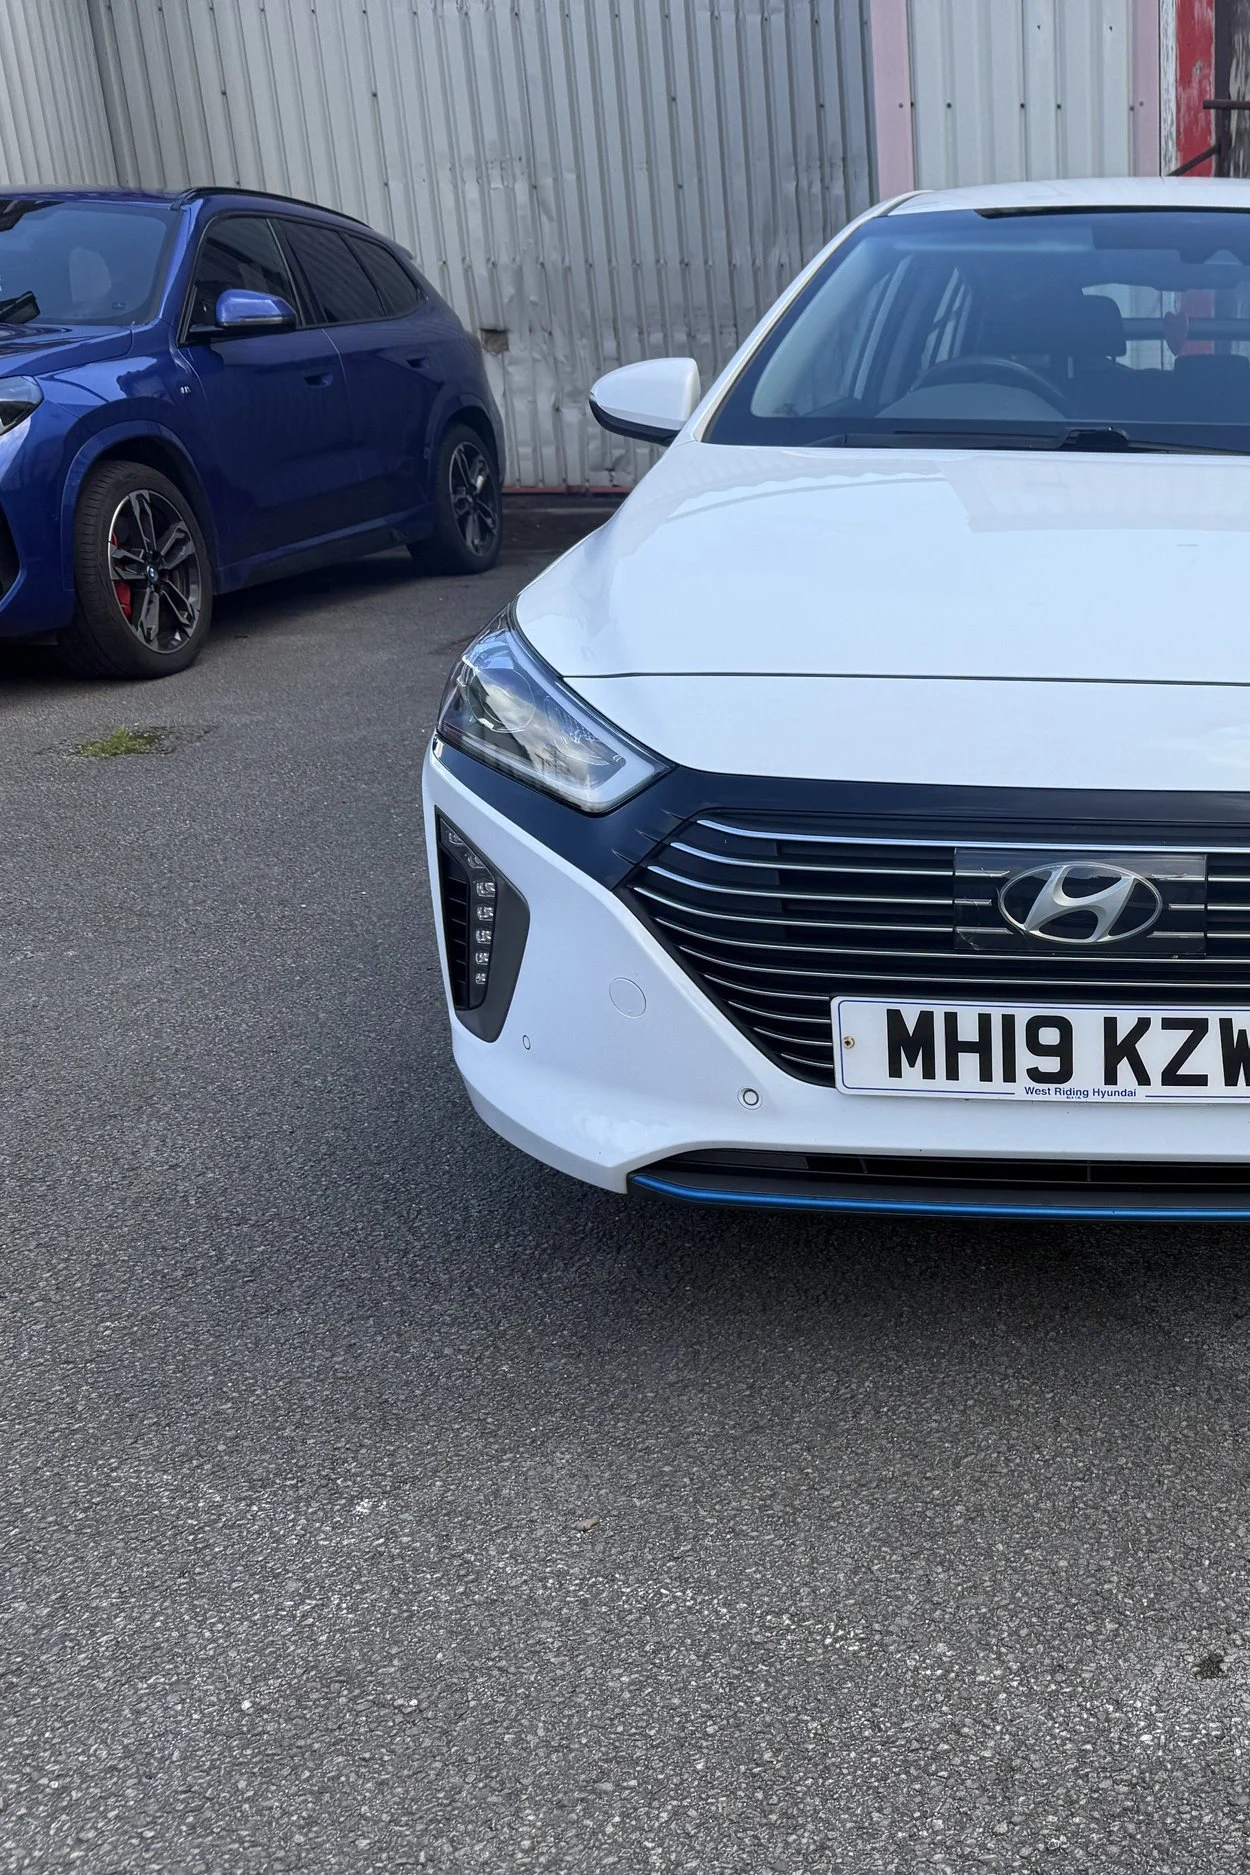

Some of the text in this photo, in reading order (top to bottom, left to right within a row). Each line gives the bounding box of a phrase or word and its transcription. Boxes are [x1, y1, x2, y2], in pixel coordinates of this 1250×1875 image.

[887, 1009, 1074, 1085] MH19
[1024, 1086, 1137, 1099] West Riding Hyundai
